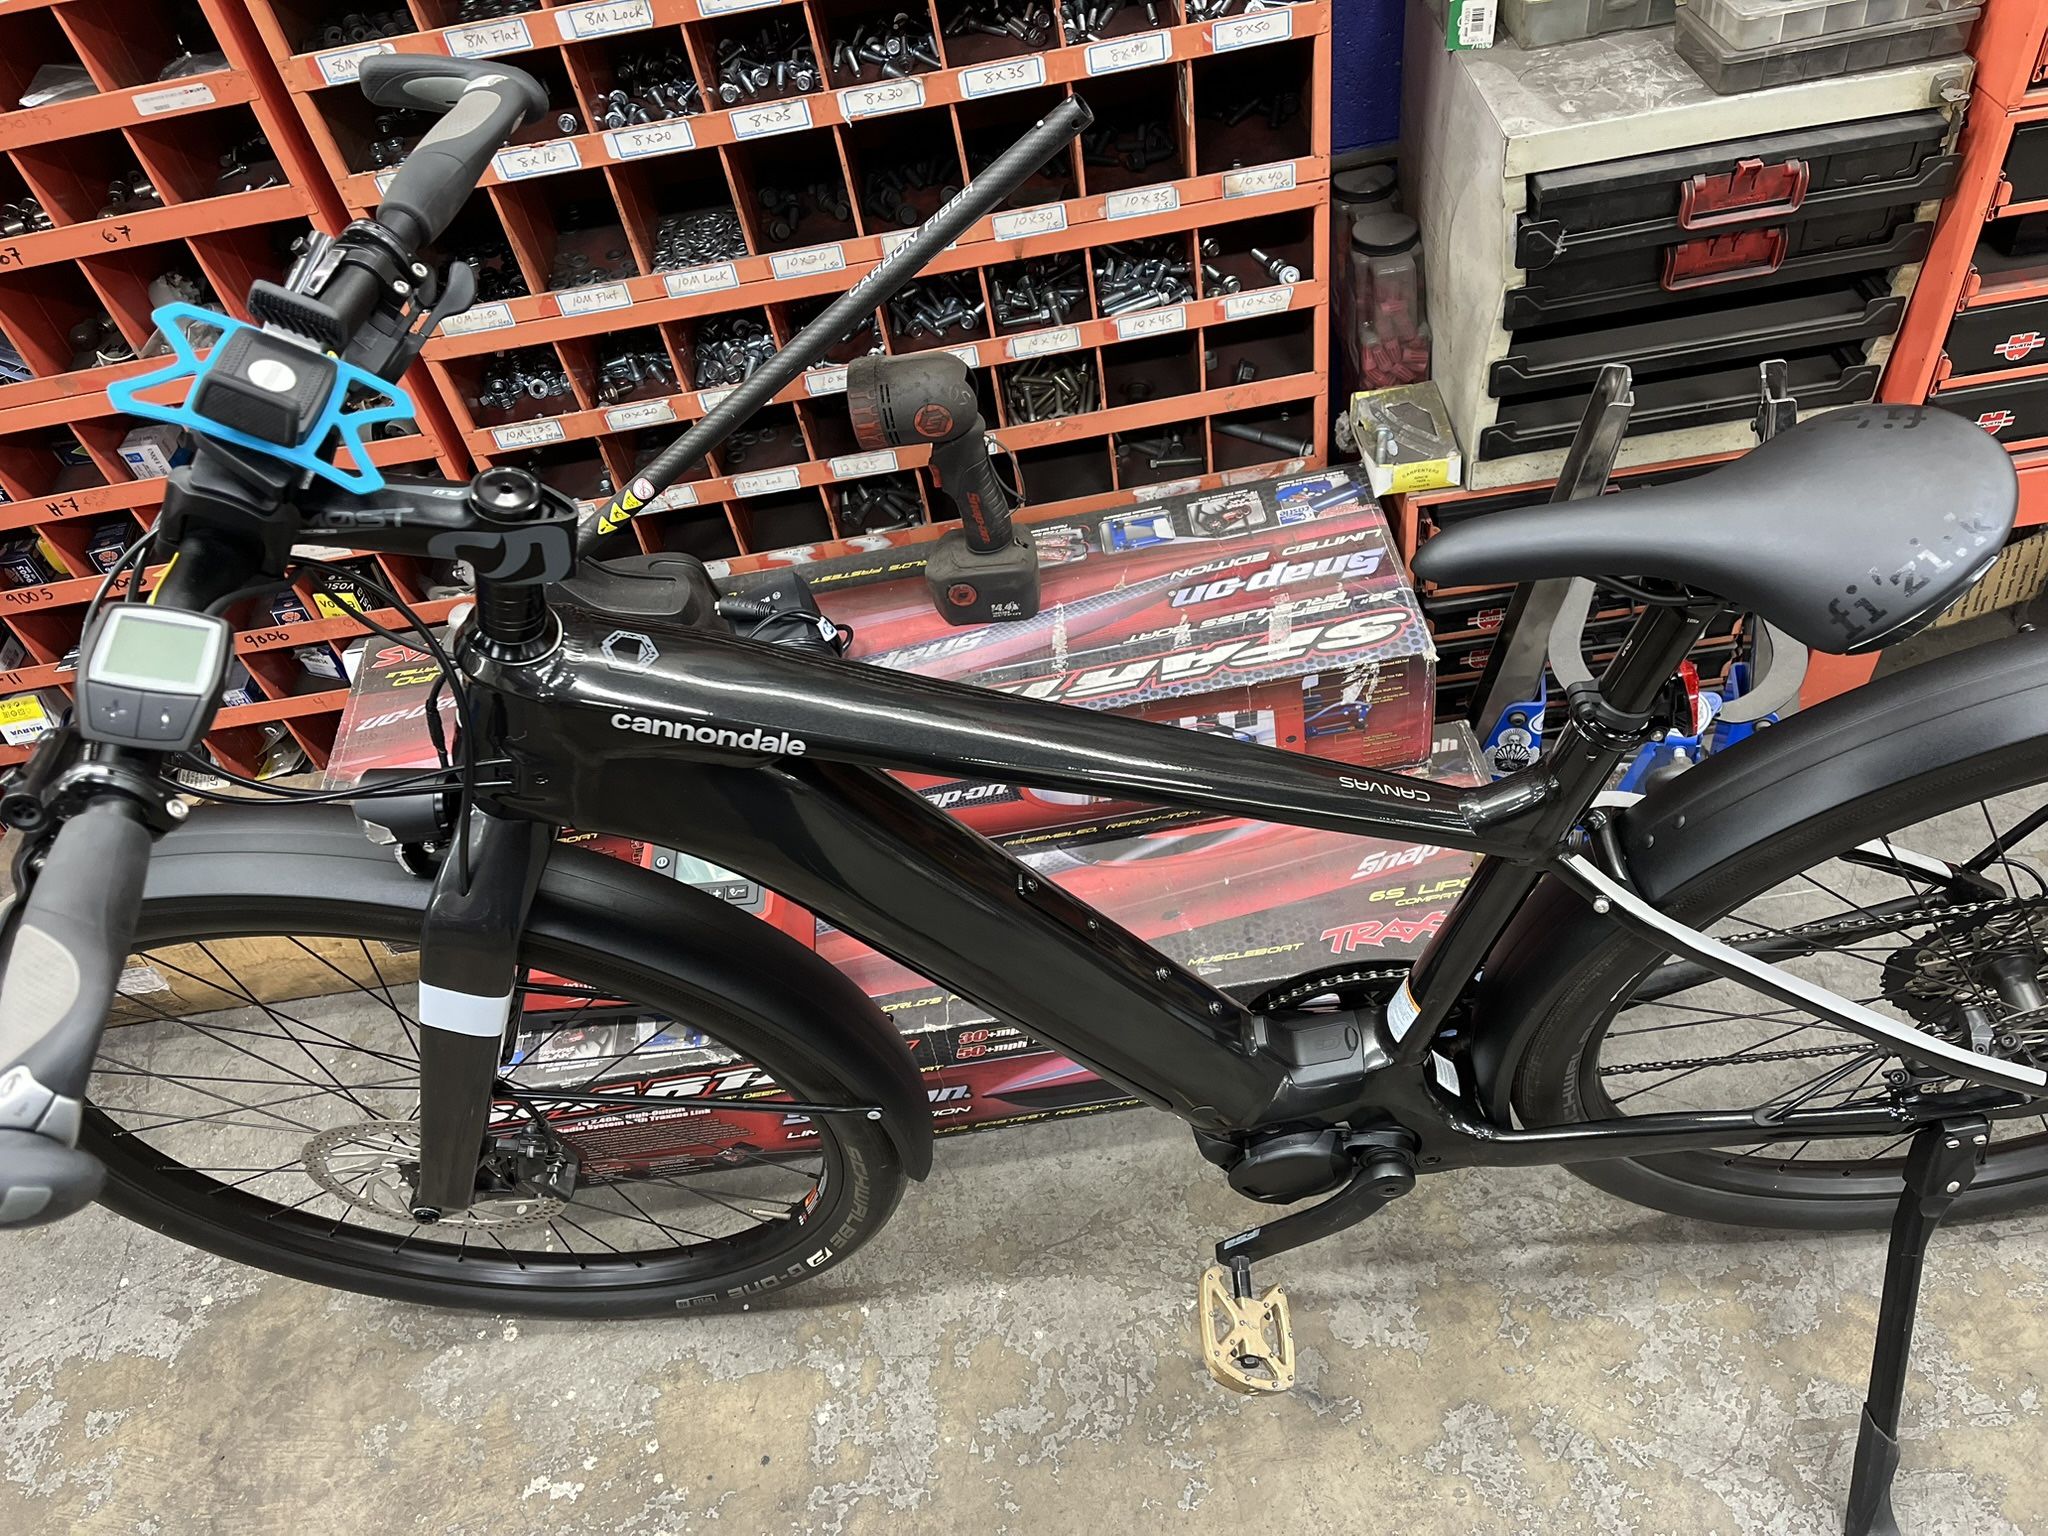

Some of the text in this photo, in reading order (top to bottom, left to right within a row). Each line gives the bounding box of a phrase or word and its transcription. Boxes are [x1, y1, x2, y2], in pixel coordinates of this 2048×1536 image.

[584, 4, 644, 26] 8M Lock
[464, 27, 521, 46] 8M Flat
[847, 183, 975, 299] CARBON FIBER
[702, 269, 730, 285] Lock
[596, 289, 619, 304] Flat
[1170, 528, 1383, 580] LIMITED EDITION
[6, 588, 54, 606] 9005
[244, 631, 290, 647] 9006
[610, 712, 807, 756] cannondale
[1338, 775, 1432, 803] CANVAS
[1368, 887, 1407, 902] 6S
[1187, 942, 1305, 966] MUSCLEBOAT
[829, 1143, 871, 1249] SCHWALBE
[727, 1262, 807, 1299] G-ONE
